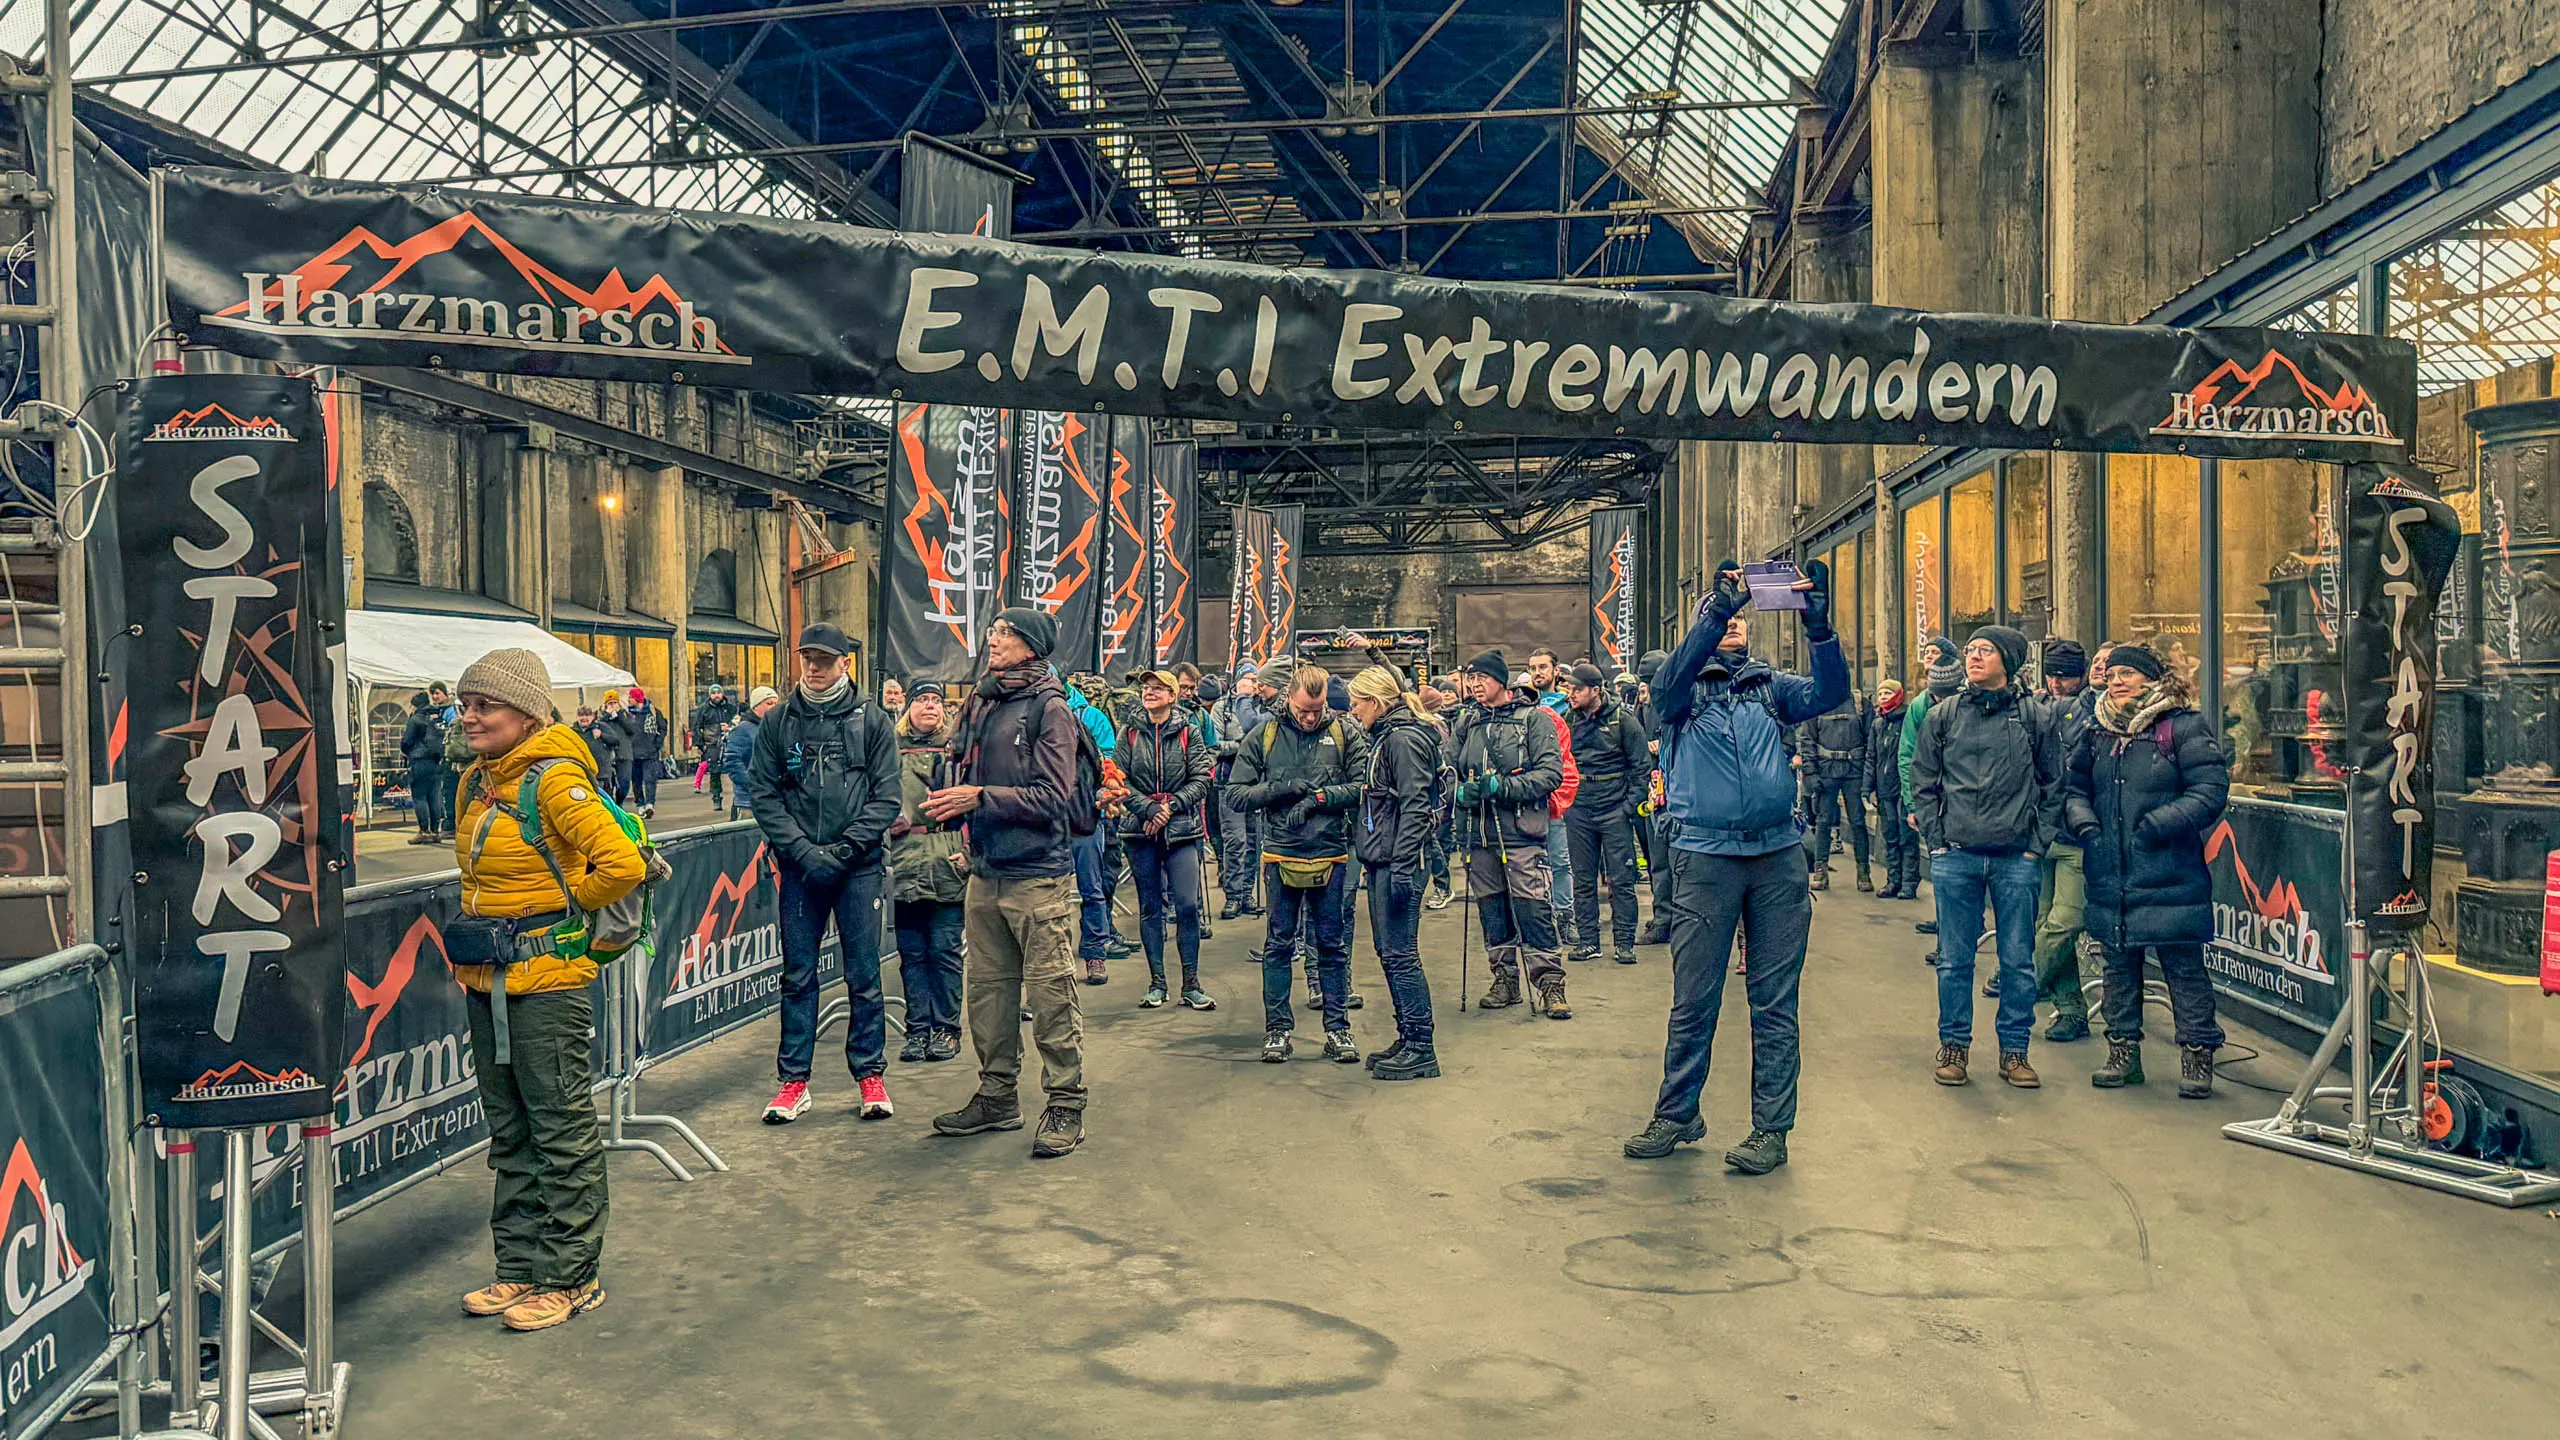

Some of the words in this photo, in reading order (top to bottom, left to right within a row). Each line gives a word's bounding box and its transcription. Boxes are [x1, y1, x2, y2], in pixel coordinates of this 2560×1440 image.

[243, 273, 719, 353] Harzmarsch
[896, 267, 1279, 397] E.M.T.I
[1331, 303, 2058, 427] Extremwandern
[153, 423, 289, 439] Harzmarsch
[2169, 392, 2389, 439] Harzmarsch
[1611, 540, 1629, 668] Harzmarsch
[2380, 507, 2428, 880] START
[172, 455, 291, 1043] START
[677, 923, 783, 992] Harzm
[2203, 943, 2304, 1004] Extremwandern
[181, 1074, 316, 1098] Harzmarsch
